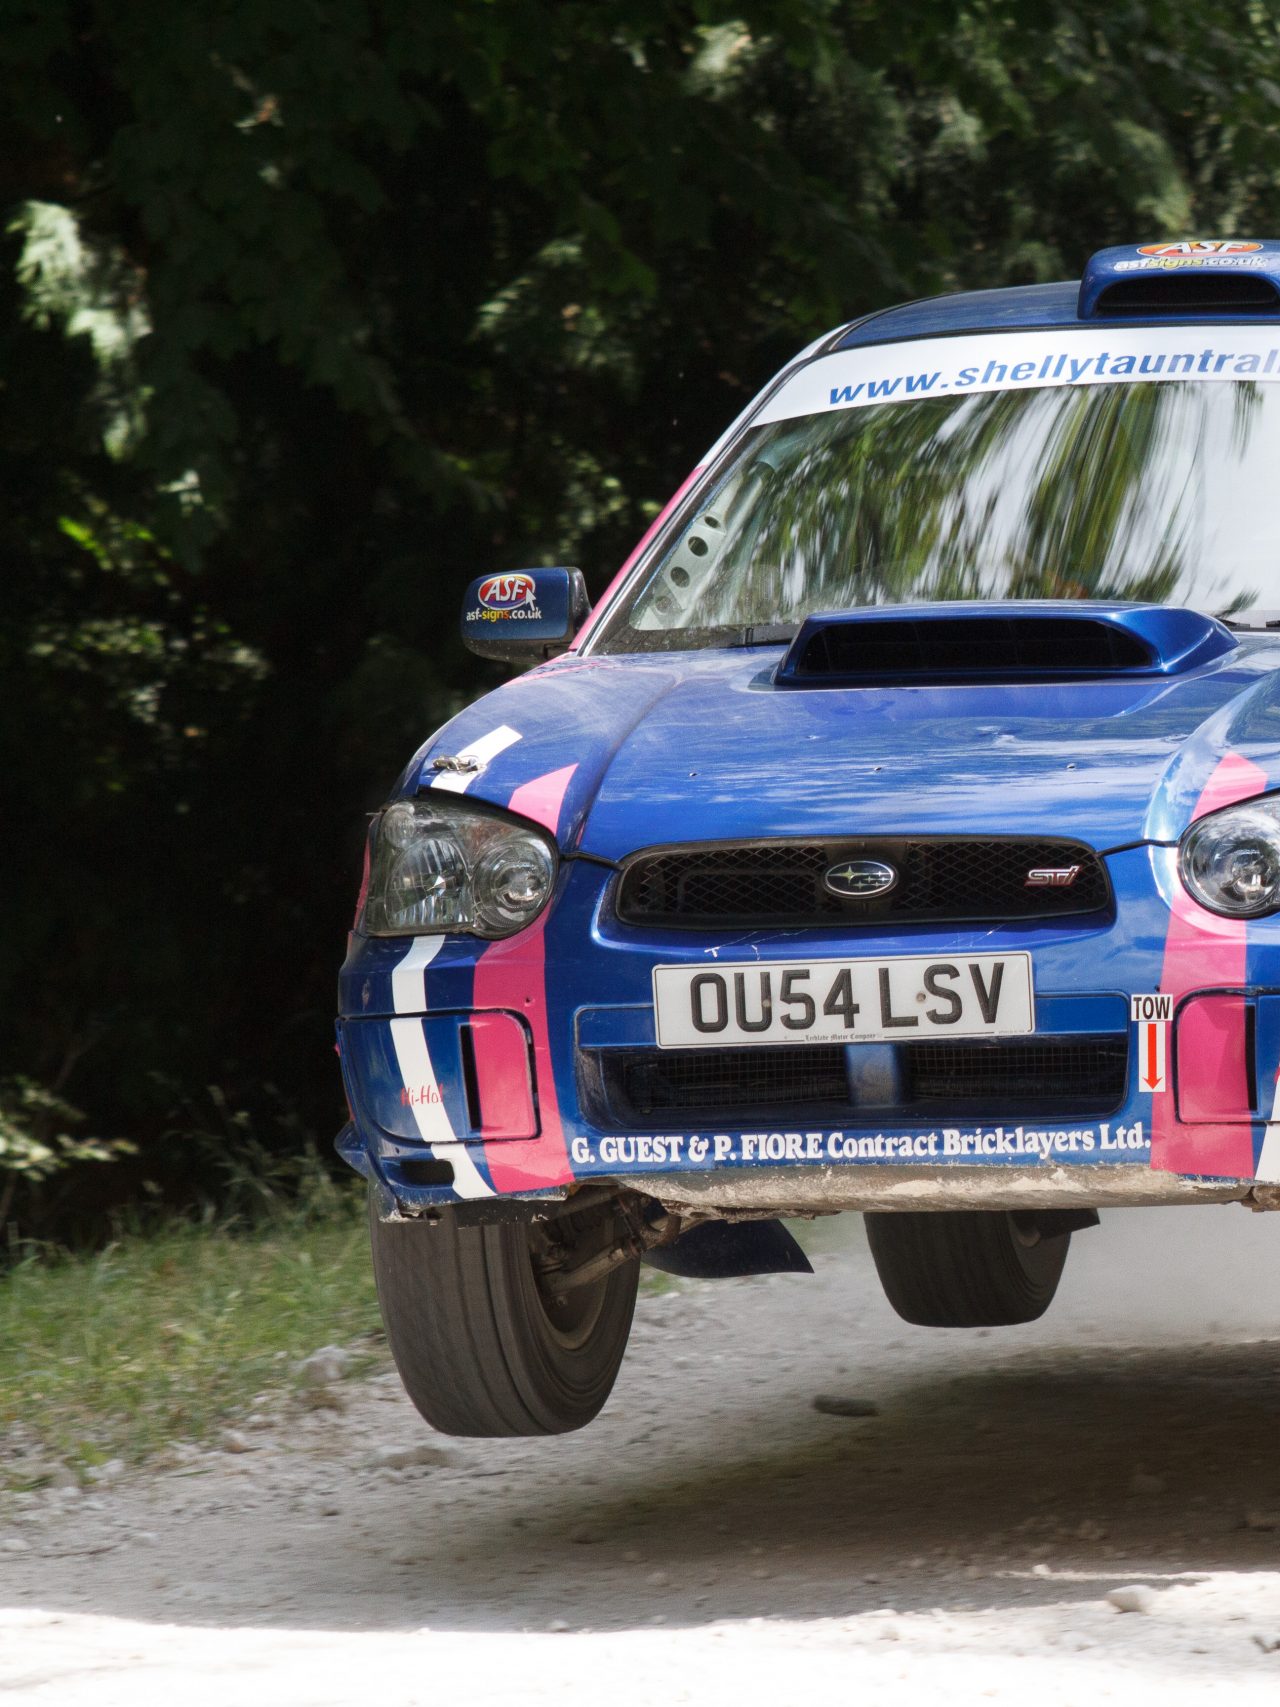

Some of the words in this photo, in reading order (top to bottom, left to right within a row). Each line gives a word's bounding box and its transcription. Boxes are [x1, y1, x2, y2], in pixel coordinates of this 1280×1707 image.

[1155, 240, 1251, 254] ASF
[484, 576, 527, 601] ASF
[466, 607, 542, 622] asf-signs.co.uk
[690, 968, 860, 1034] OU54
[878, 962, 1005, 1028] LSV
[1133, 996, 1172, 1020] TOW
[572, 1137, 595, 1163] G.
[600, 1136, 683, 1163] GUEST
[688, 1136, 709, 1162] &
[713, 1135, 736, 1161] P.
[741, 1133, 823, 1160] FIORE
[827, 1131, 938, 1158] Contract
[942, 1126, 1095, 1159] Bricklayers
[1099, 1121, 1152, 1150] Ltd.
